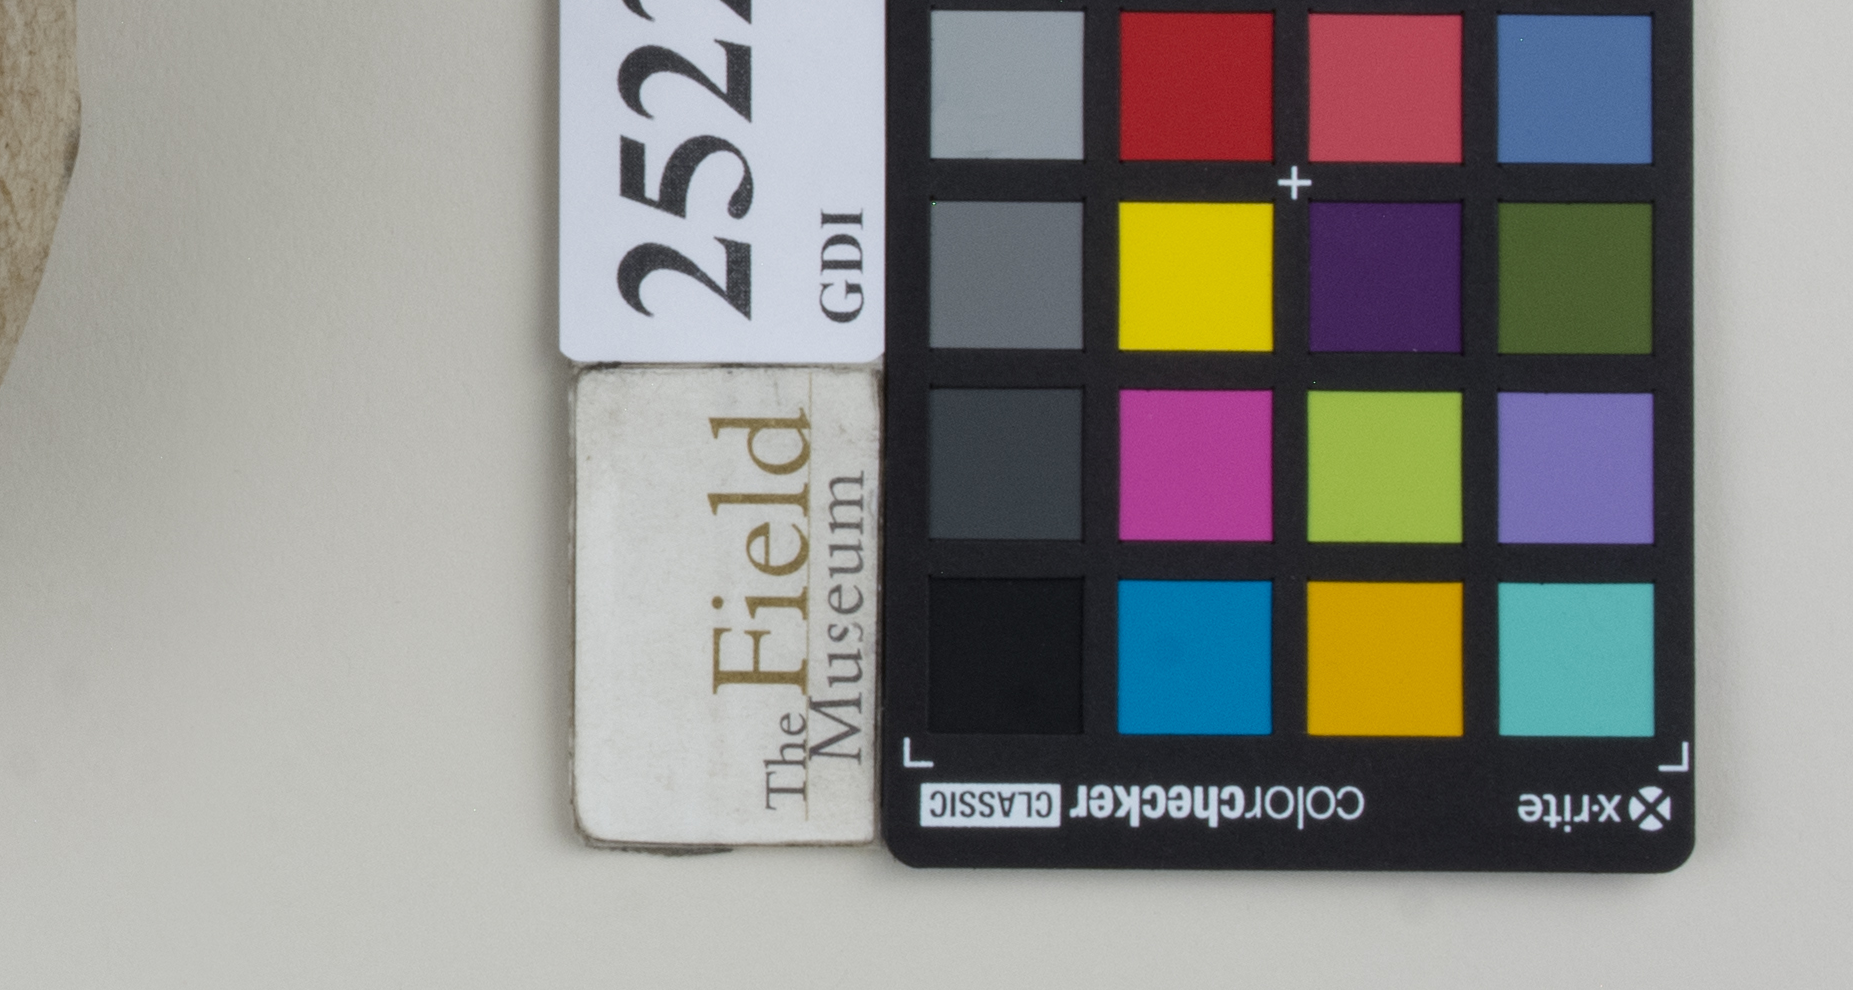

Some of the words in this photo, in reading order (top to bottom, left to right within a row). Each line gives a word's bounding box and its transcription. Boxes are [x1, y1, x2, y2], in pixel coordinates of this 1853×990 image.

[819, 208, 864, 324] GDI
[710, 408, 809, 696] Field
[811, 470, 866, 762] Museum
[764, 712, 808, 810] The
[929, 790, 1051, 819] CLASSIC
[1069, 784, 1365, 829] colorchecker
